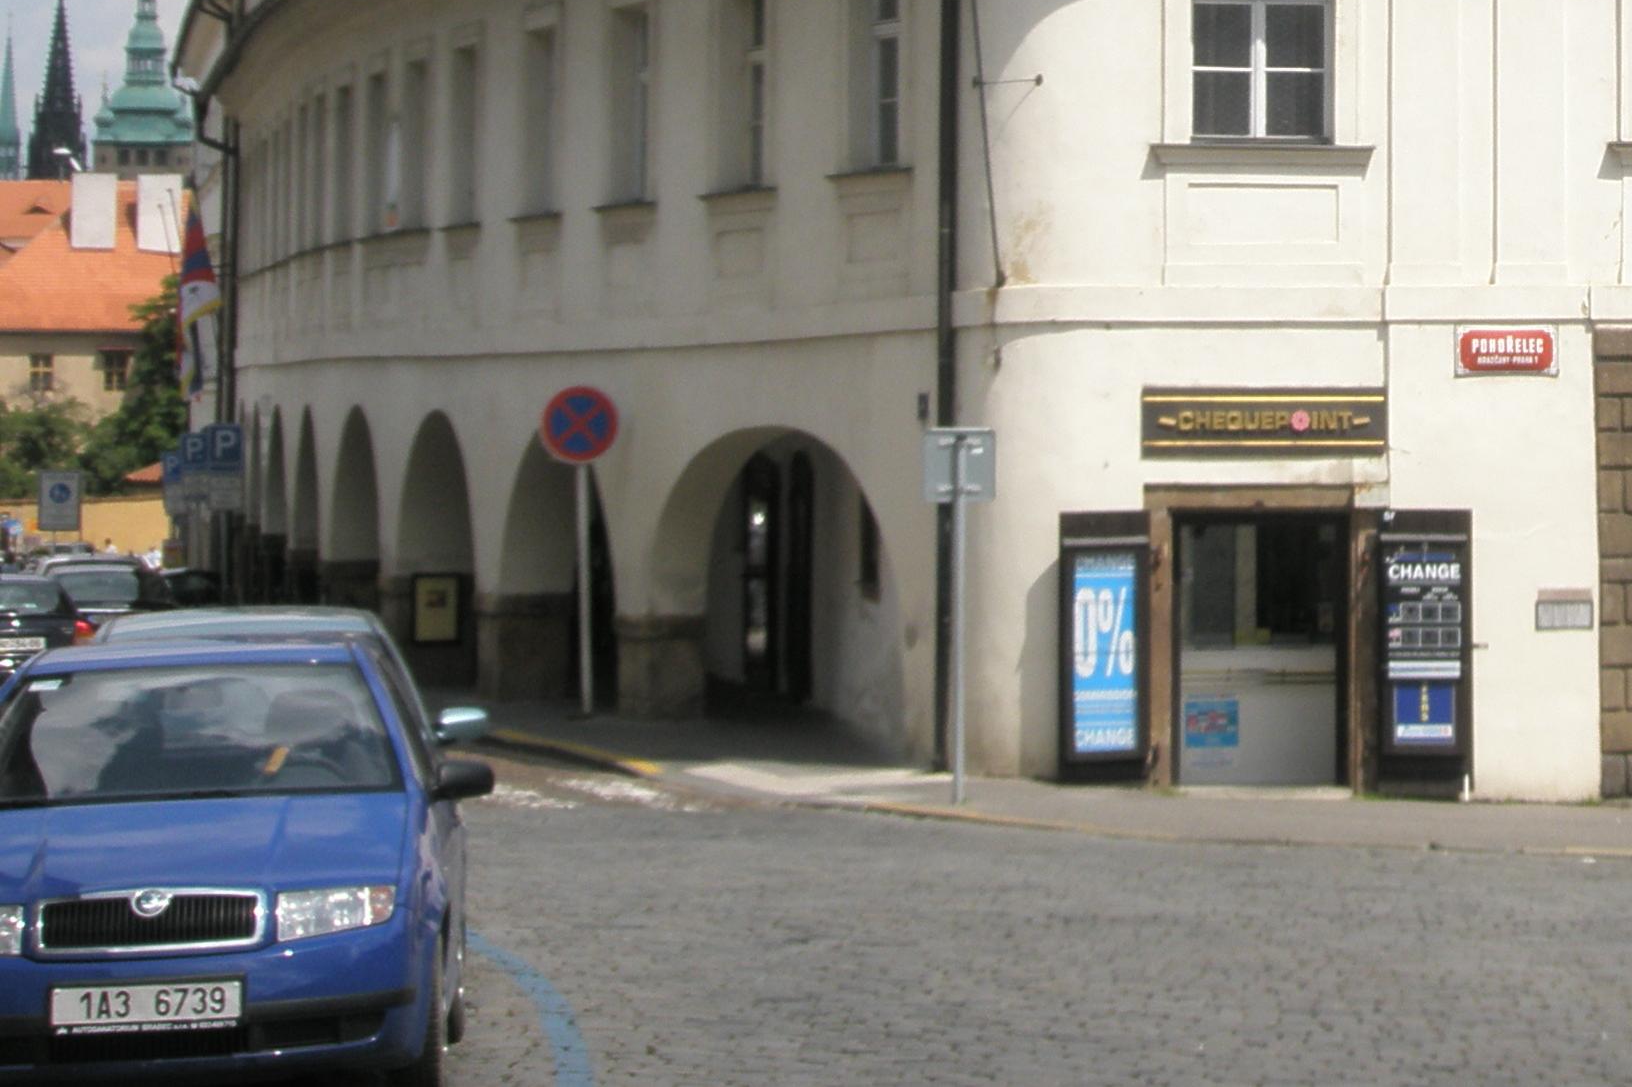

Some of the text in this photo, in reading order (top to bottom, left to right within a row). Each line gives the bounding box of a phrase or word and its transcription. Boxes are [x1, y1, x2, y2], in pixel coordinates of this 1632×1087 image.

[1471, 335, 1544, 354] POHOŘELEC
[1178, 410, 1353, 431] CHEQUEPOINT
[187, 437, 203, 460] P
[216, 430, 236, 459] P
[1388, 563, 1461, 580] CHANGE
[1075, 587, 1135, 678] 0%
[1075, 728, 1135, 747] CHANGE
[80, 986, 226, 1019] 1A3 6739
